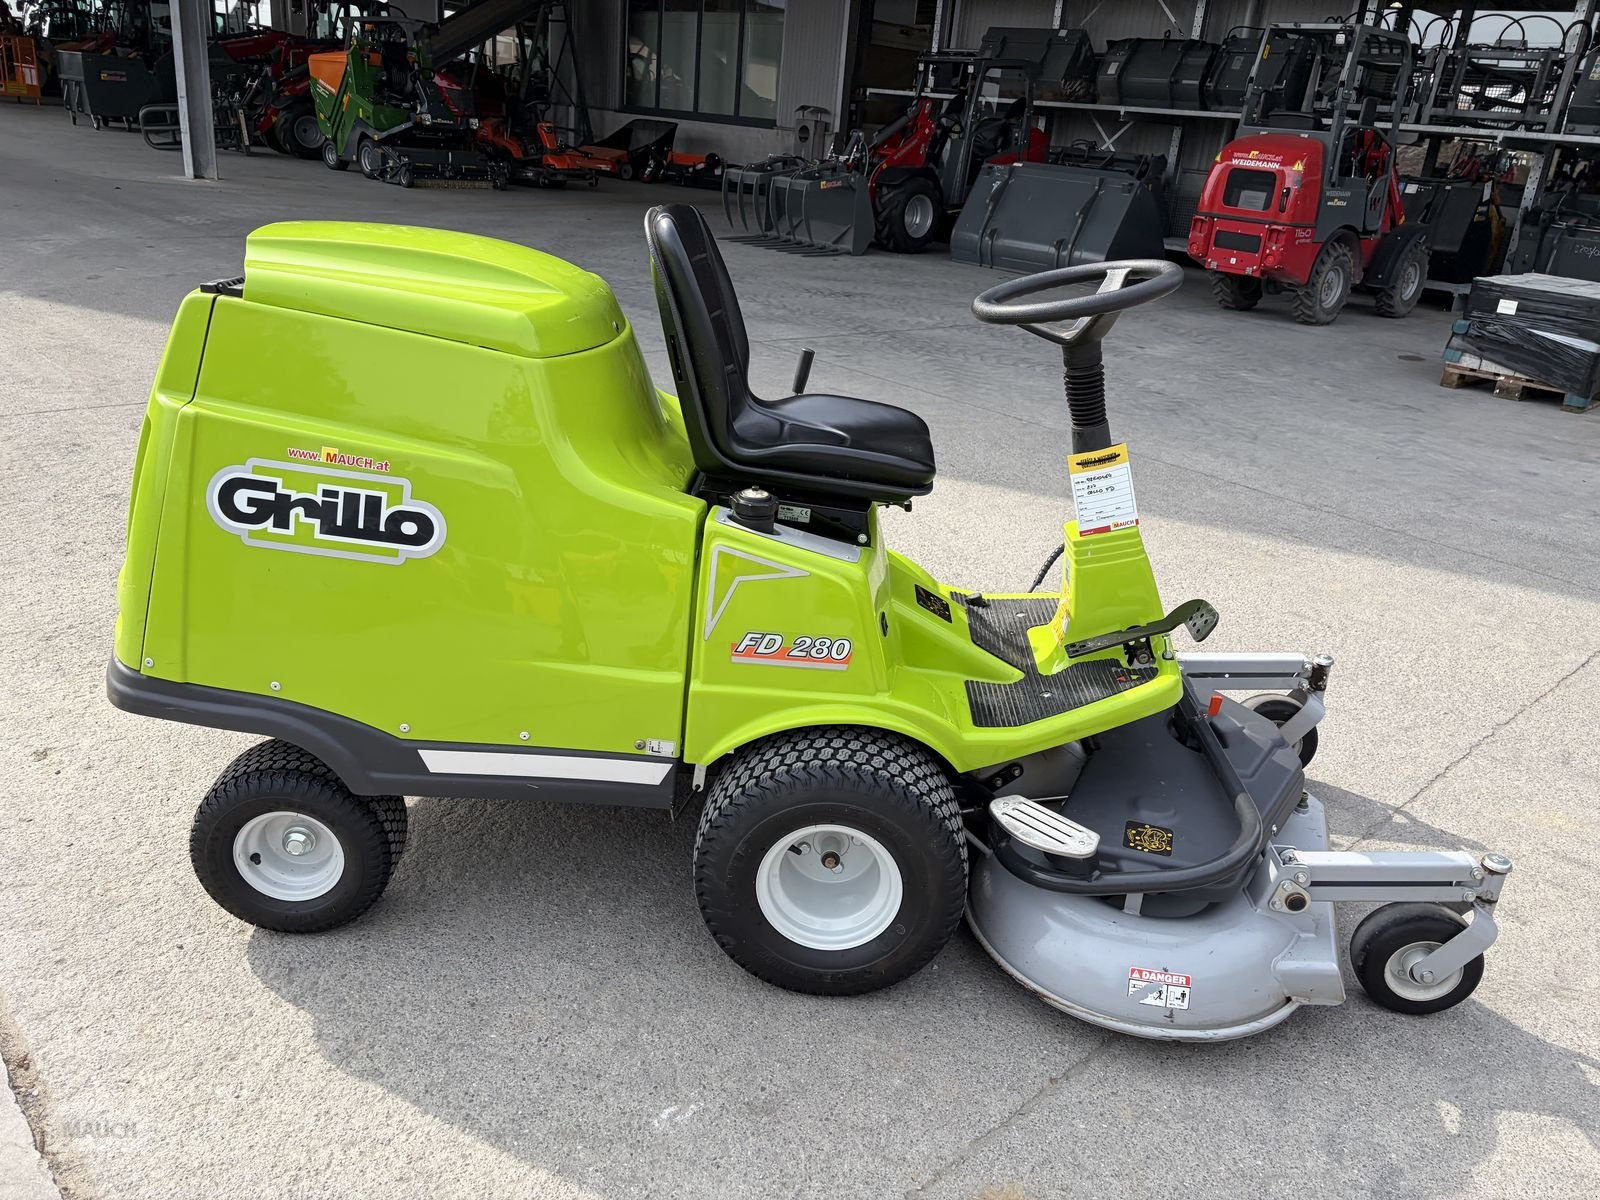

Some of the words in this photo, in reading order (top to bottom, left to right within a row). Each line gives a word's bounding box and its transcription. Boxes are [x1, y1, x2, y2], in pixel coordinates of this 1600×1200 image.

[1232, 158, 1280, 169] WEIDEMANN
[1295, 229, 1311, 238] 1160
[217, 476, 435, 547] Grillo
[1113, 520, 1134, 529] MAUCH
[735, 632, 784, 655] FD
[787, 635, 852, 661] 280
[1141, 971, 1187, 985] DANGER
